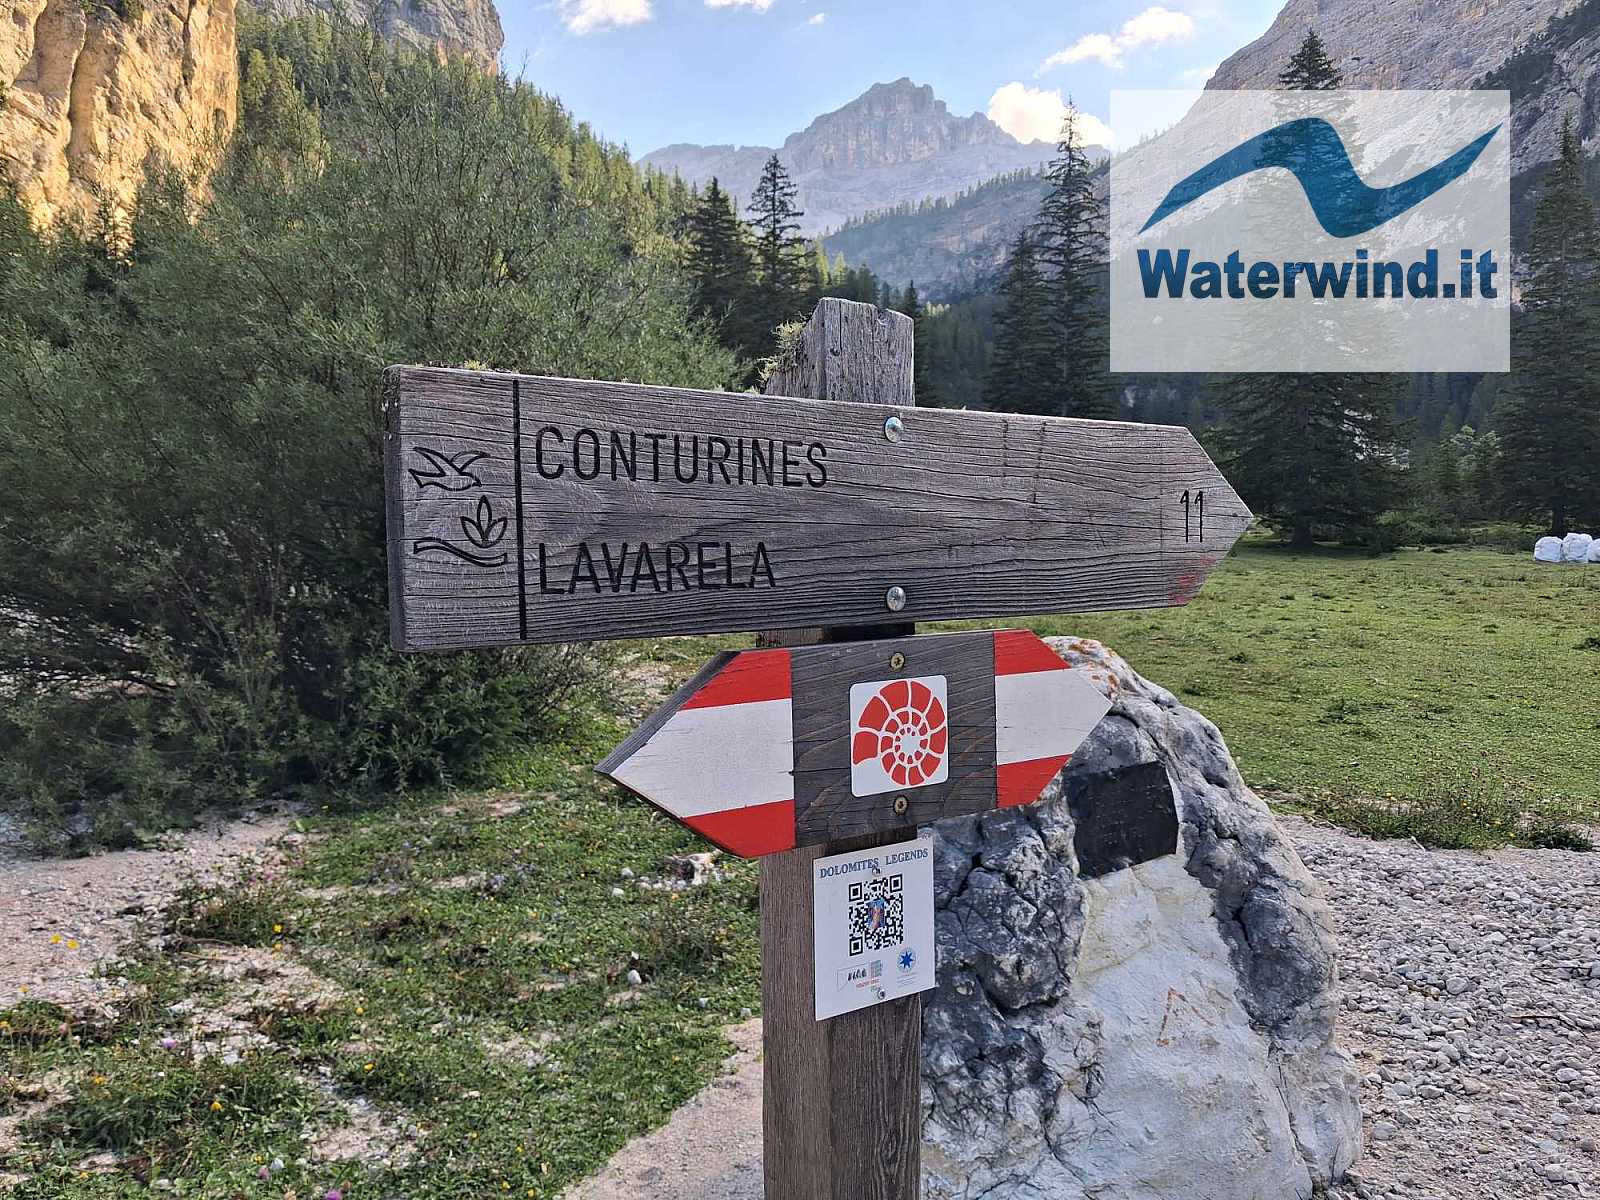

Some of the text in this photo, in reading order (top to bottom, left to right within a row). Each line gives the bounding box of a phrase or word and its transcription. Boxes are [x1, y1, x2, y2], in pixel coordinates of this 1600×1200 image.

[536, 425, 828, 488] CONTURINES
[1180, 489, 1203, 543] 11
[538, 541, 777, 594] LAVARELA
[820, 848, 928, 879] DOLOMITES LEGENDS
